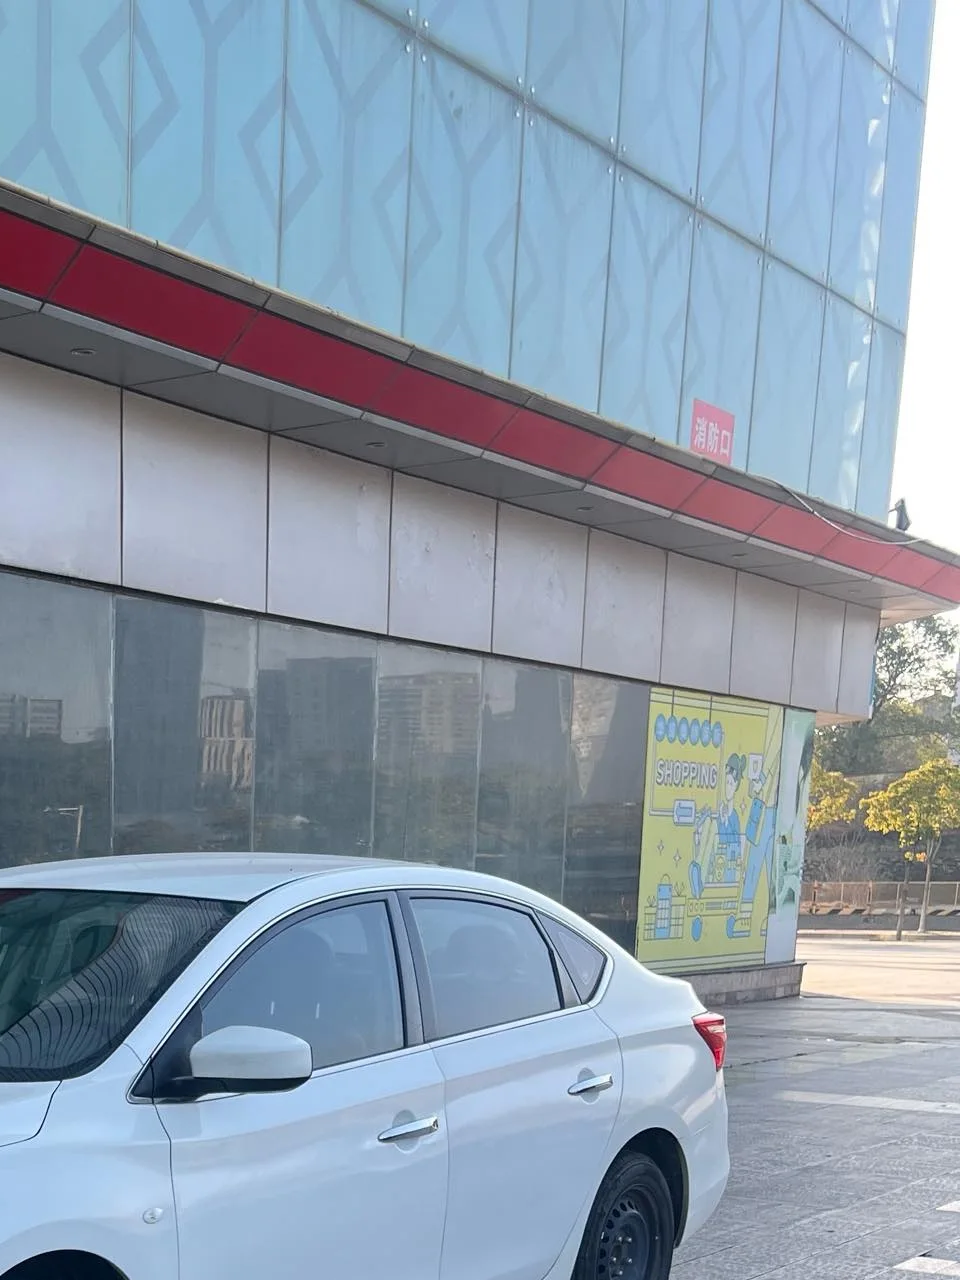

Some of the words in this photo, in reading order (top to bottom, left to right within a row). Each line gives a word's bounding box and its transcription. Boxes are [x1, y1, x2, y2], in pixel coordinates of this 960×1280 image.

[694, 416, 731, 457] 消防口
[656, 758, 717, 789] SHOPPING
